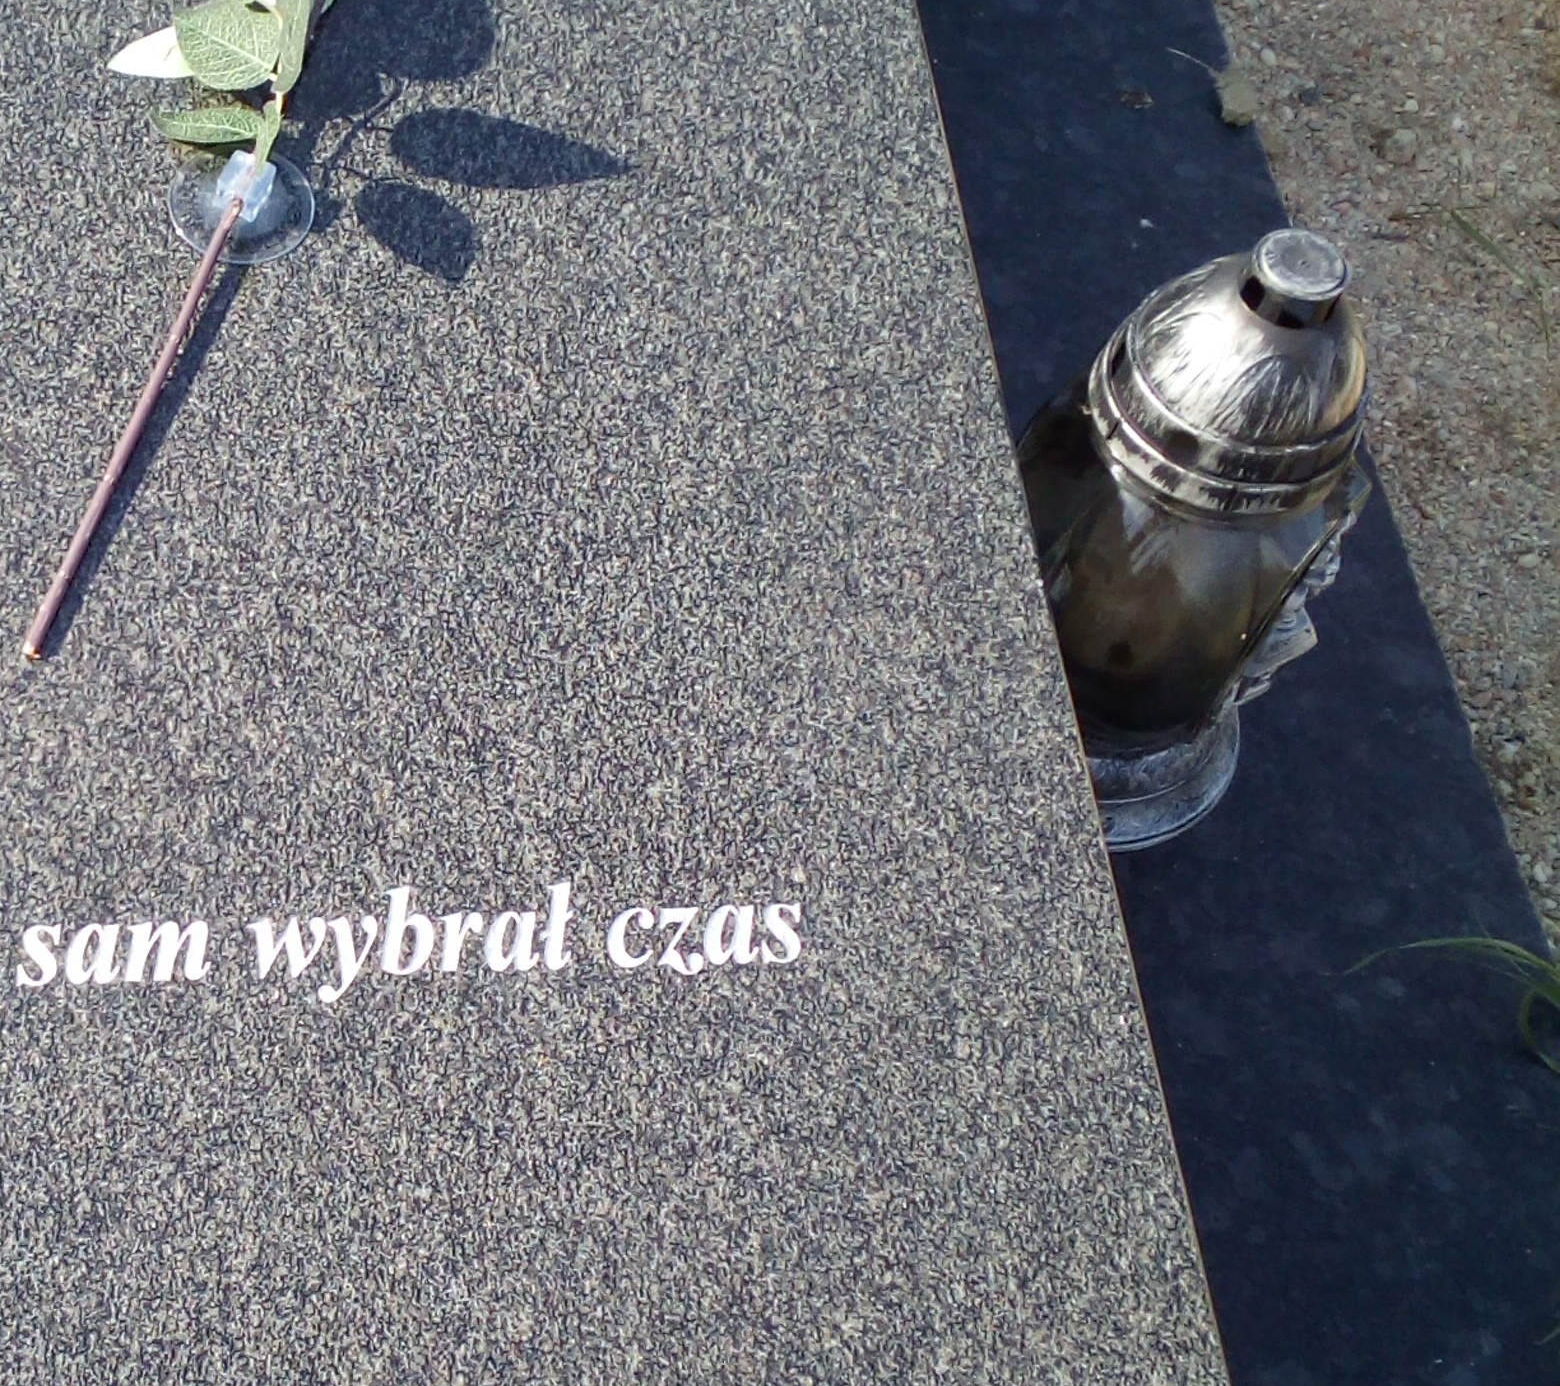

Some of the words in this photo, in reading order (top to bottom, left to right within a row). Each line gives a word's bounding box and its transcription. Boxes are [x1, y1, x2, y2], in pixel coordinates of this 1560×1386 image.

[15, 915, 211, 986] sam
[246, 883, 573, 1003] wybrał
[606, 901, 803, 976] czas
